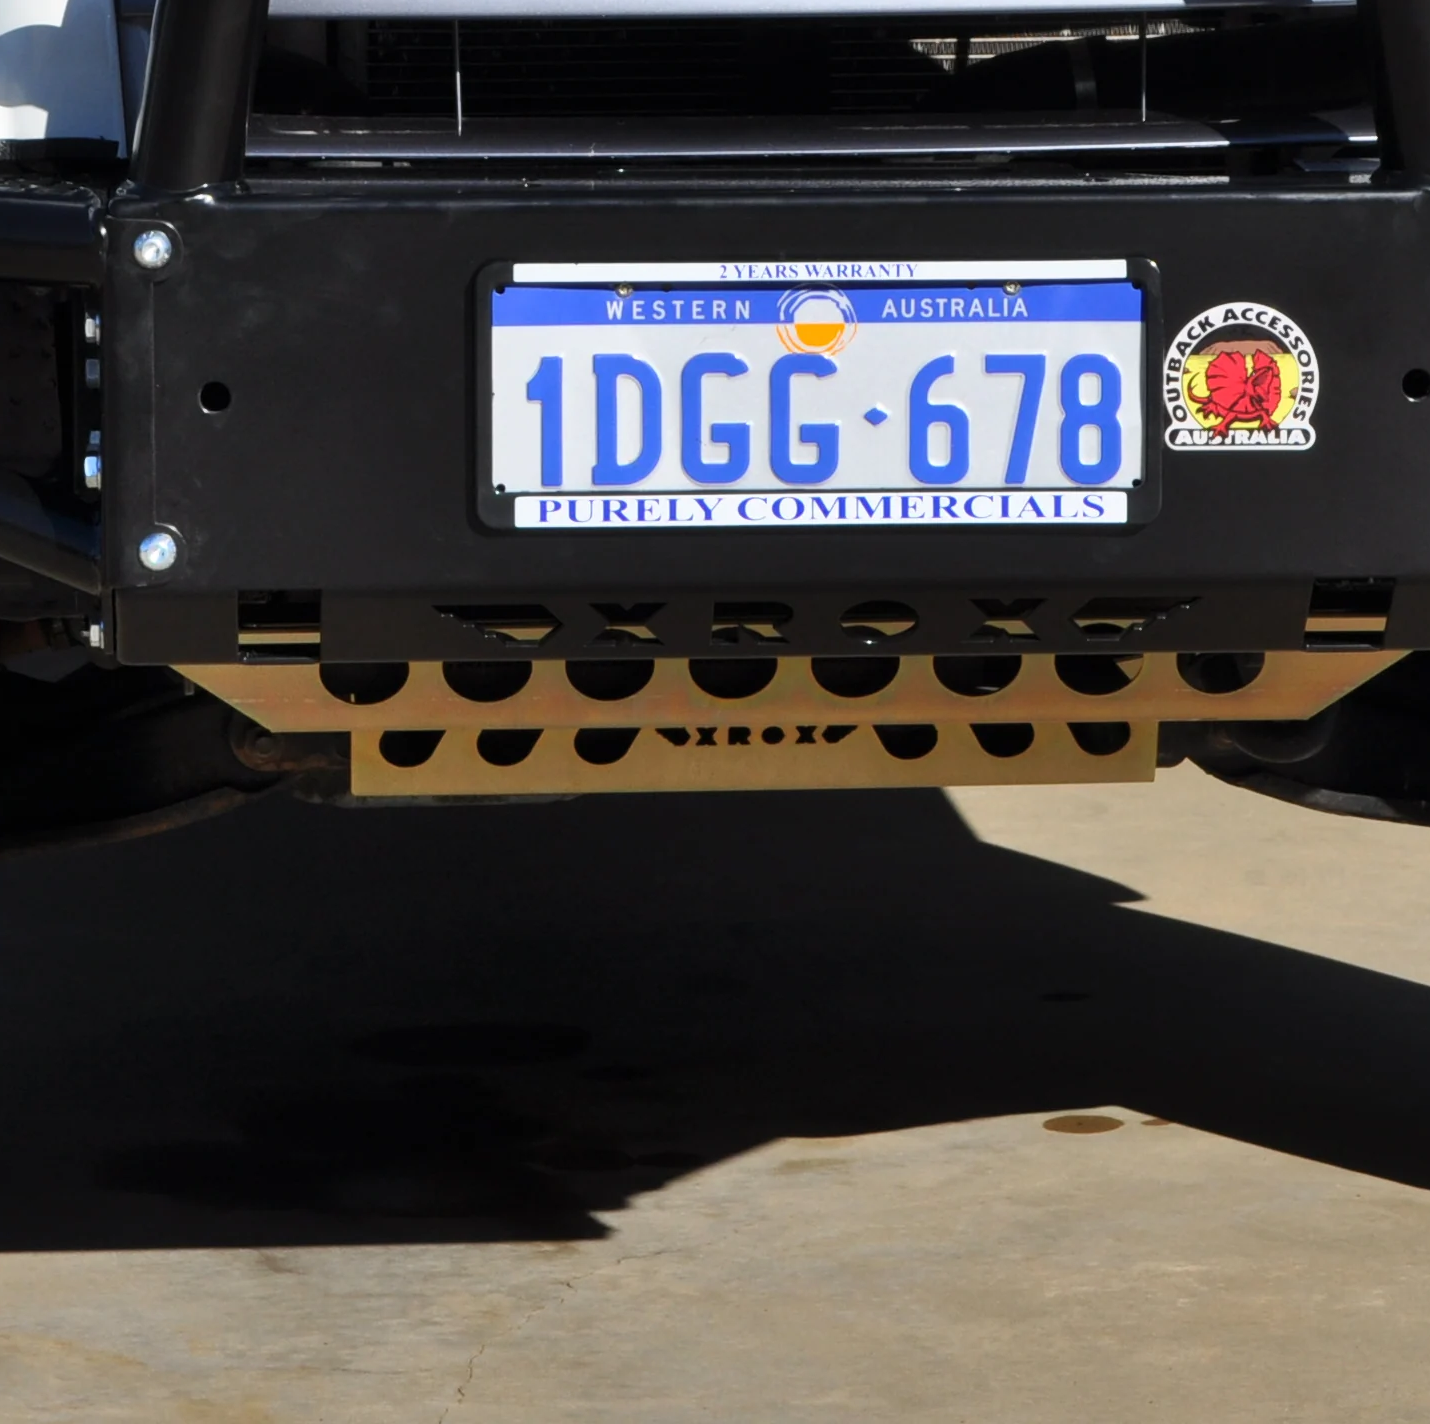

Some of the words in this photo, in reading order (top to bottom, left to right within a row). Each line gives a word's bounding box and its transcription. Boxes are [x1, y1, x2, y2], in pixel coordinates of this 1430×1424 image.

[720, 264, 728, 279] 2
[735, 264, 799, 279] YEARS
[804, 263, 918, 278] WARRANTY
[606, 300, 751, 320] WESTERN
[881, 298, 1029, 318] AUSTRALIA
[1166, 315, 1216, 423] OUTBACK
[1222, 308, 1315, 422] ACCESSORIES
[537, 495, 725, 523] PURELY
[737, 494, 1107, 522] COMMERCIALS
